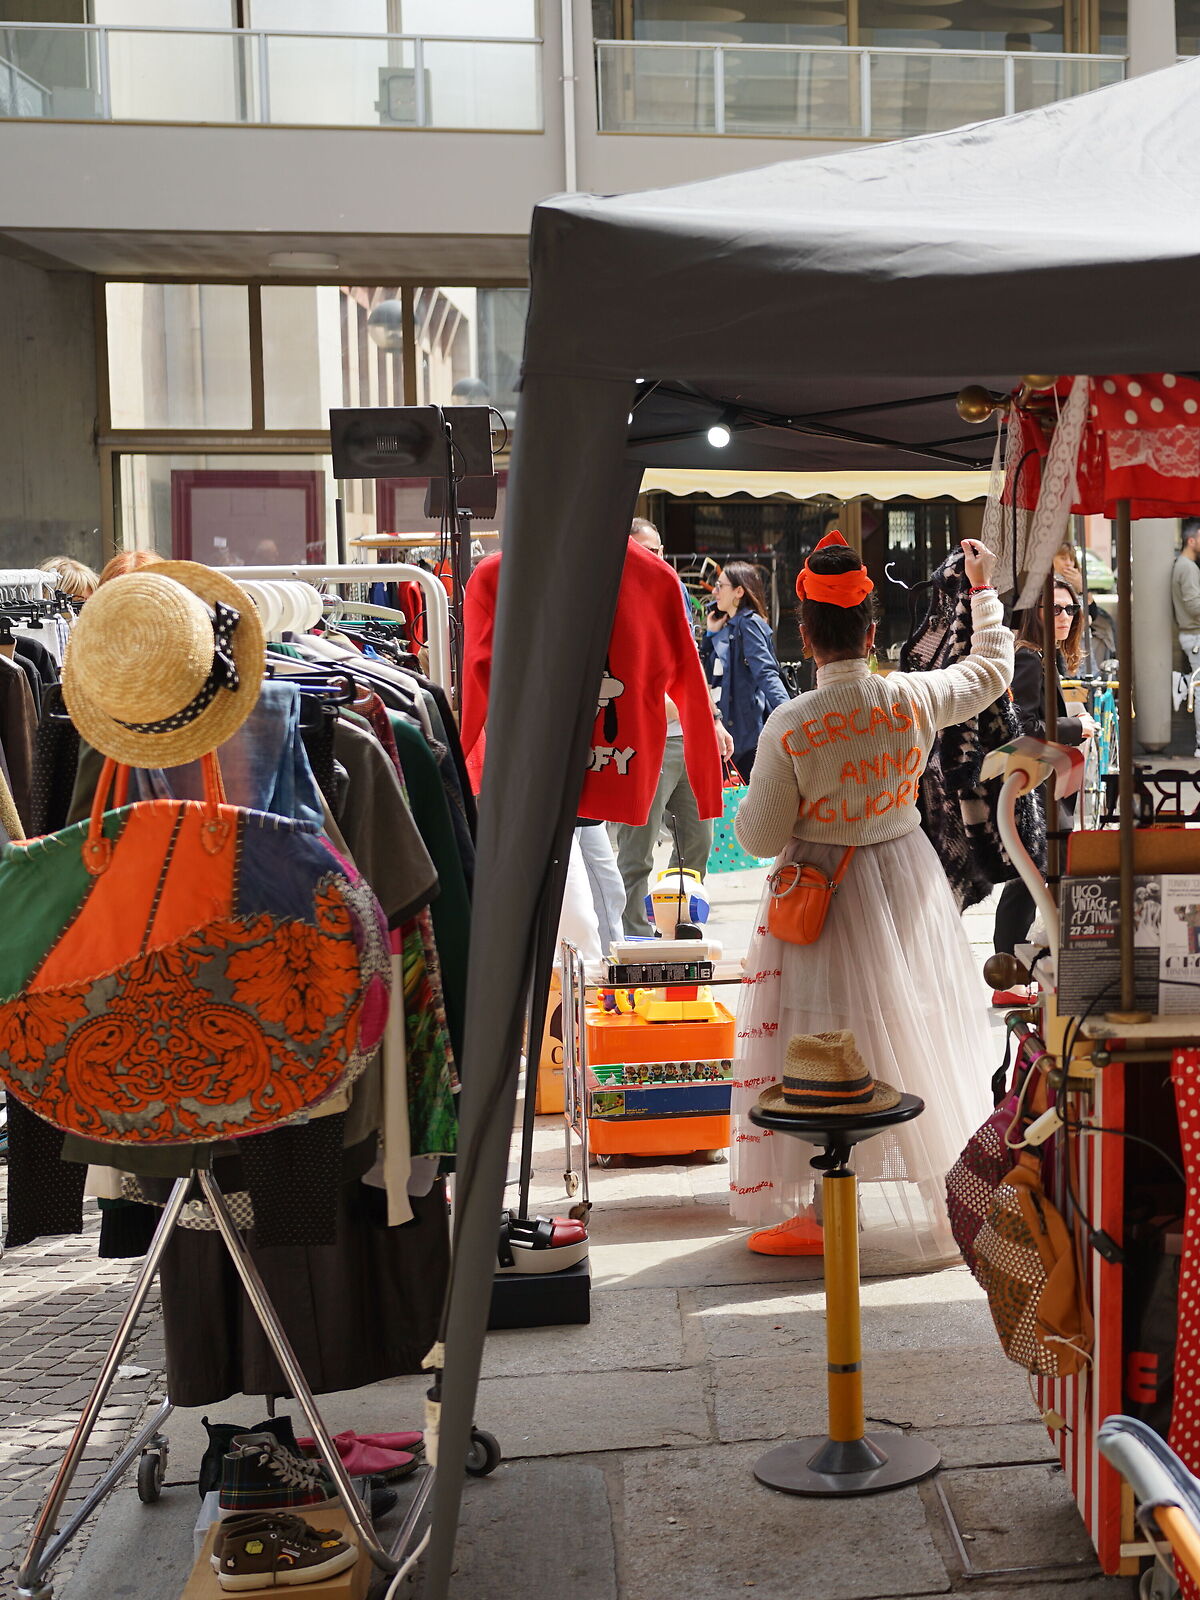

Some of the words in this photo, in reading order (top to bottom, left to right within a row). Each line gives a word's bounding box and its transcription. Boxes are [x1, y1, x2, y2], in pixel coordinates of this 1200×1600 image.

[781, 701, 921, 757] CERCASI
[587, 745, 637, 775] FY
[840, 746, 922, 785] ANNO
[1072, 884, 1102, 899] LUGO
[1071, 897, 1108, 911] VINTAGE
[1071, 910, 1112, 924] FESTIVAL
